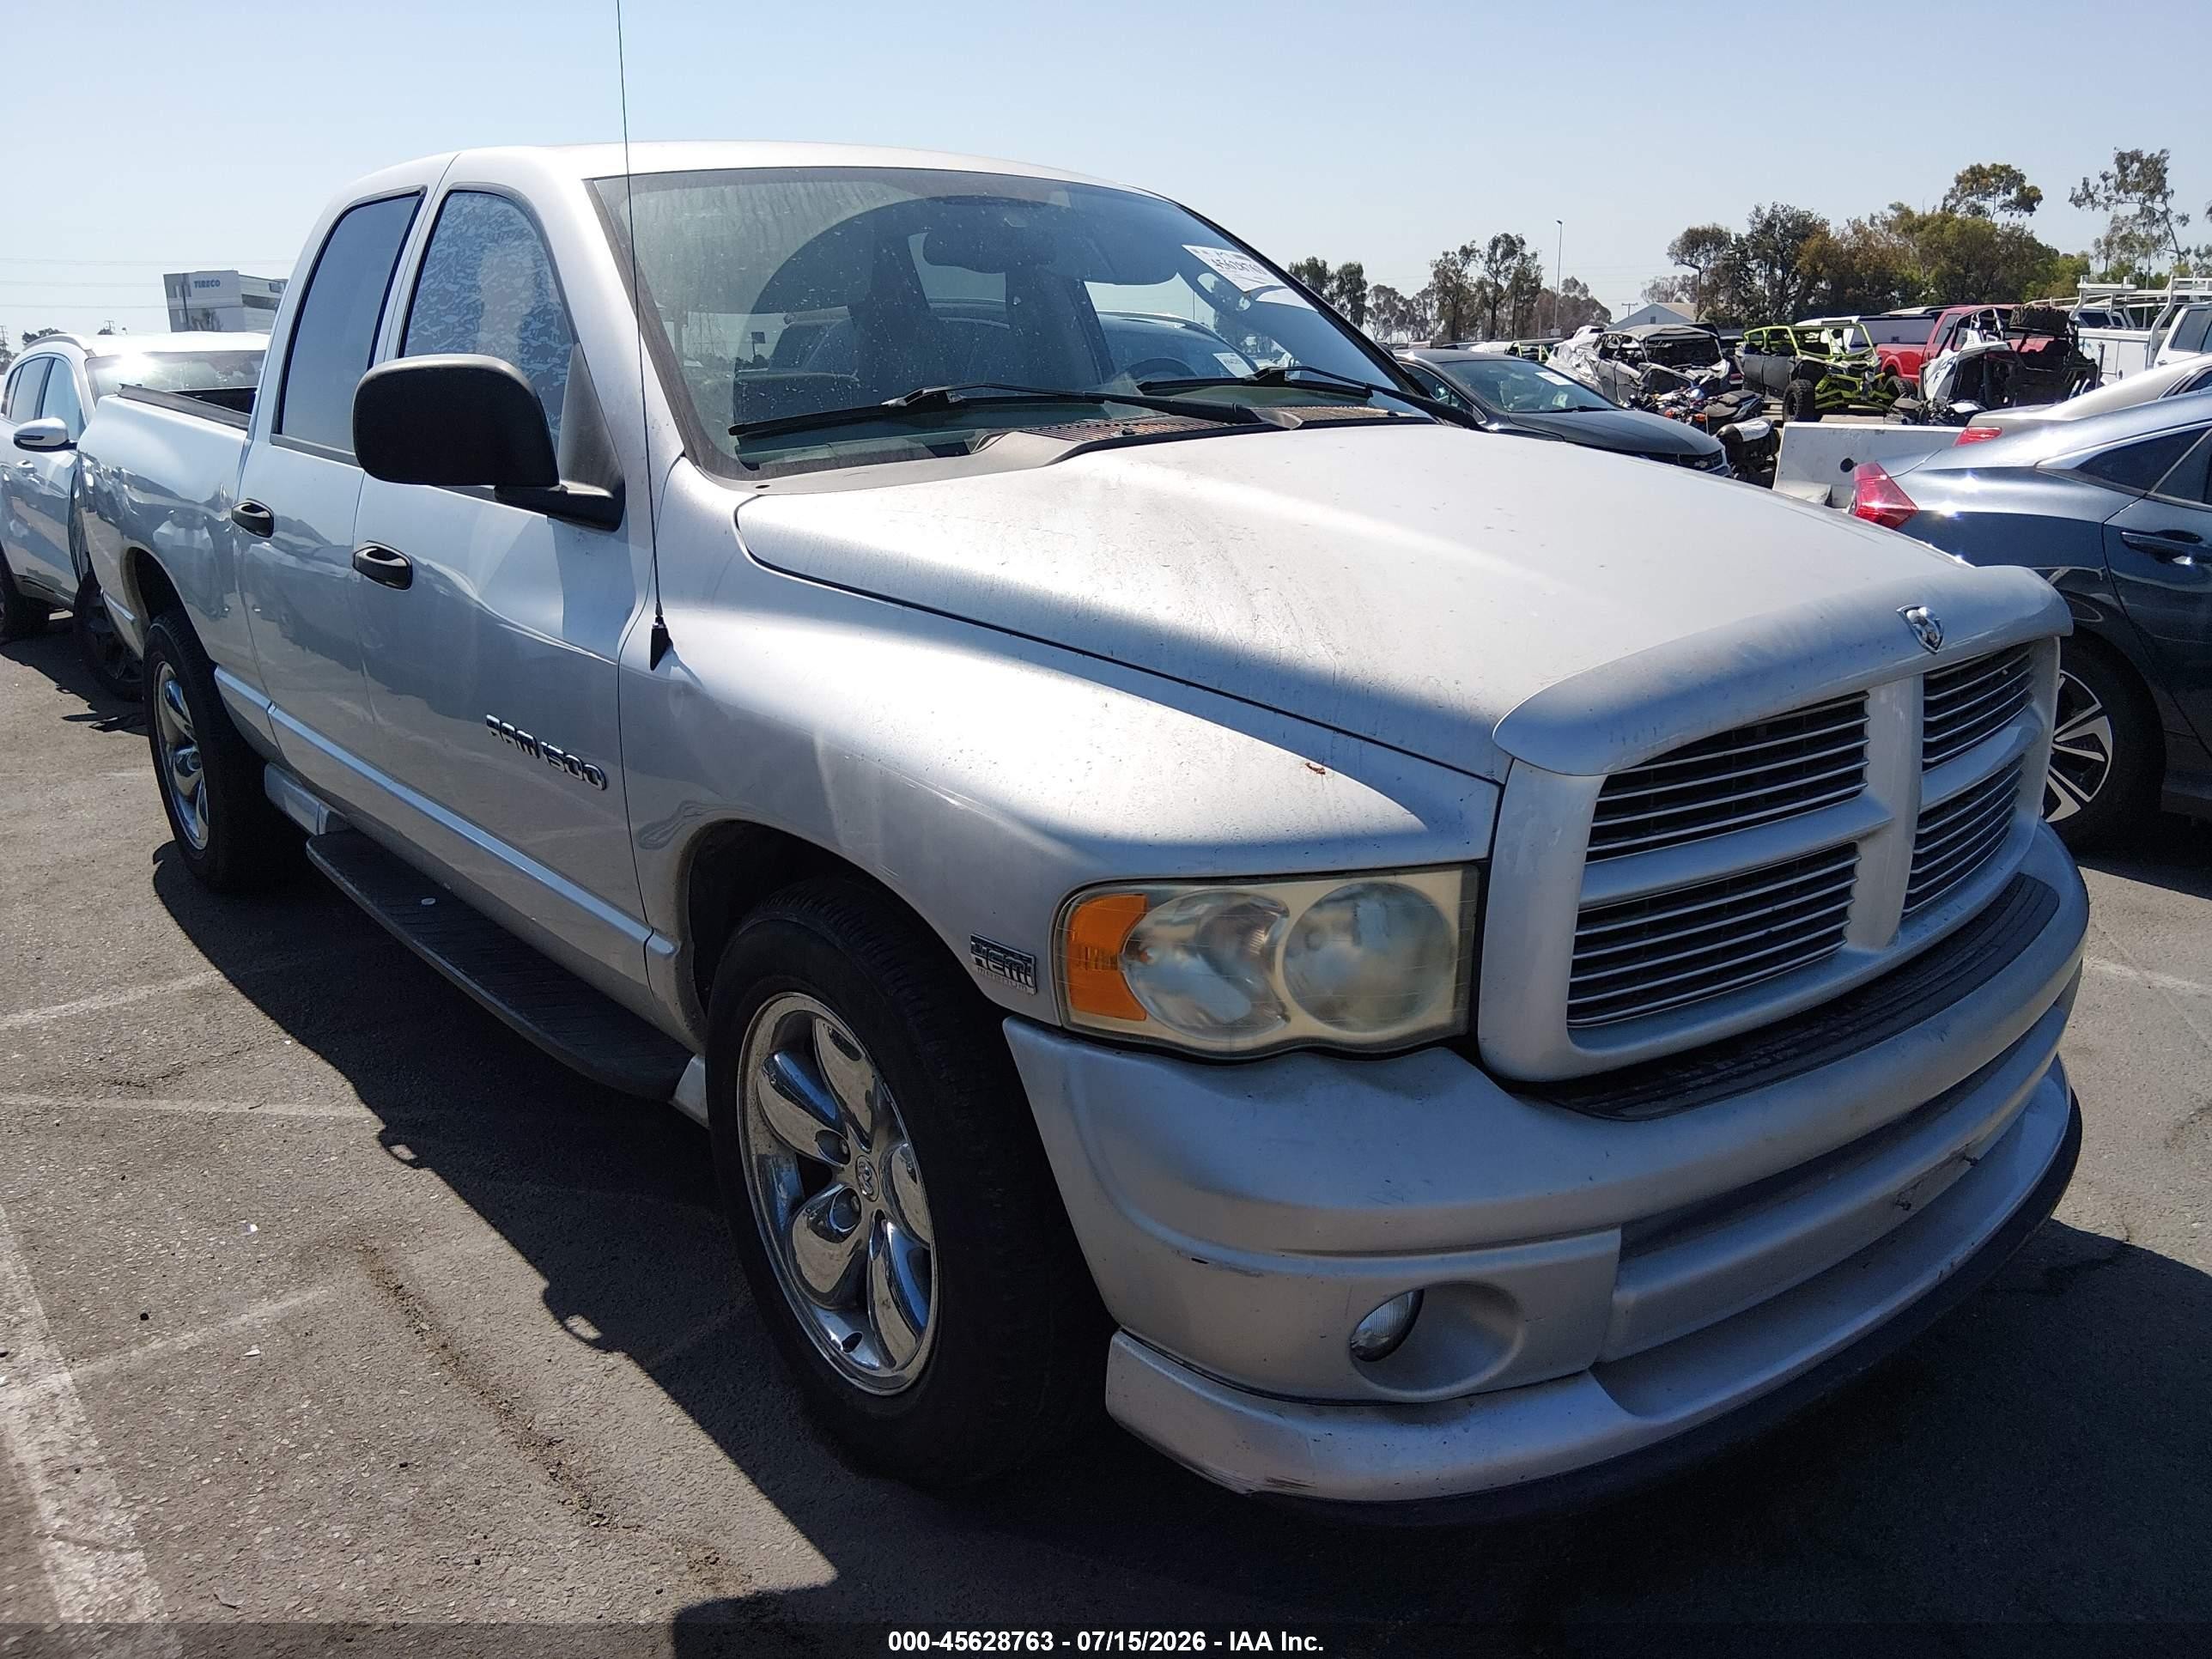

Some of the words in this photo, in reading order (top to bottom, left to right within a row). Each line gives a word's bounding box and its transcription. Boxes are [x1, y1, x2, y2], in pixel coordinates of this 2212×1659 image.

[193, 279, 221, 289] TIRECO
[485, 714, 540, 760] RAM
[540, 740, 607, 791] 1500
[970, 940, 1035, 988] HEMI
